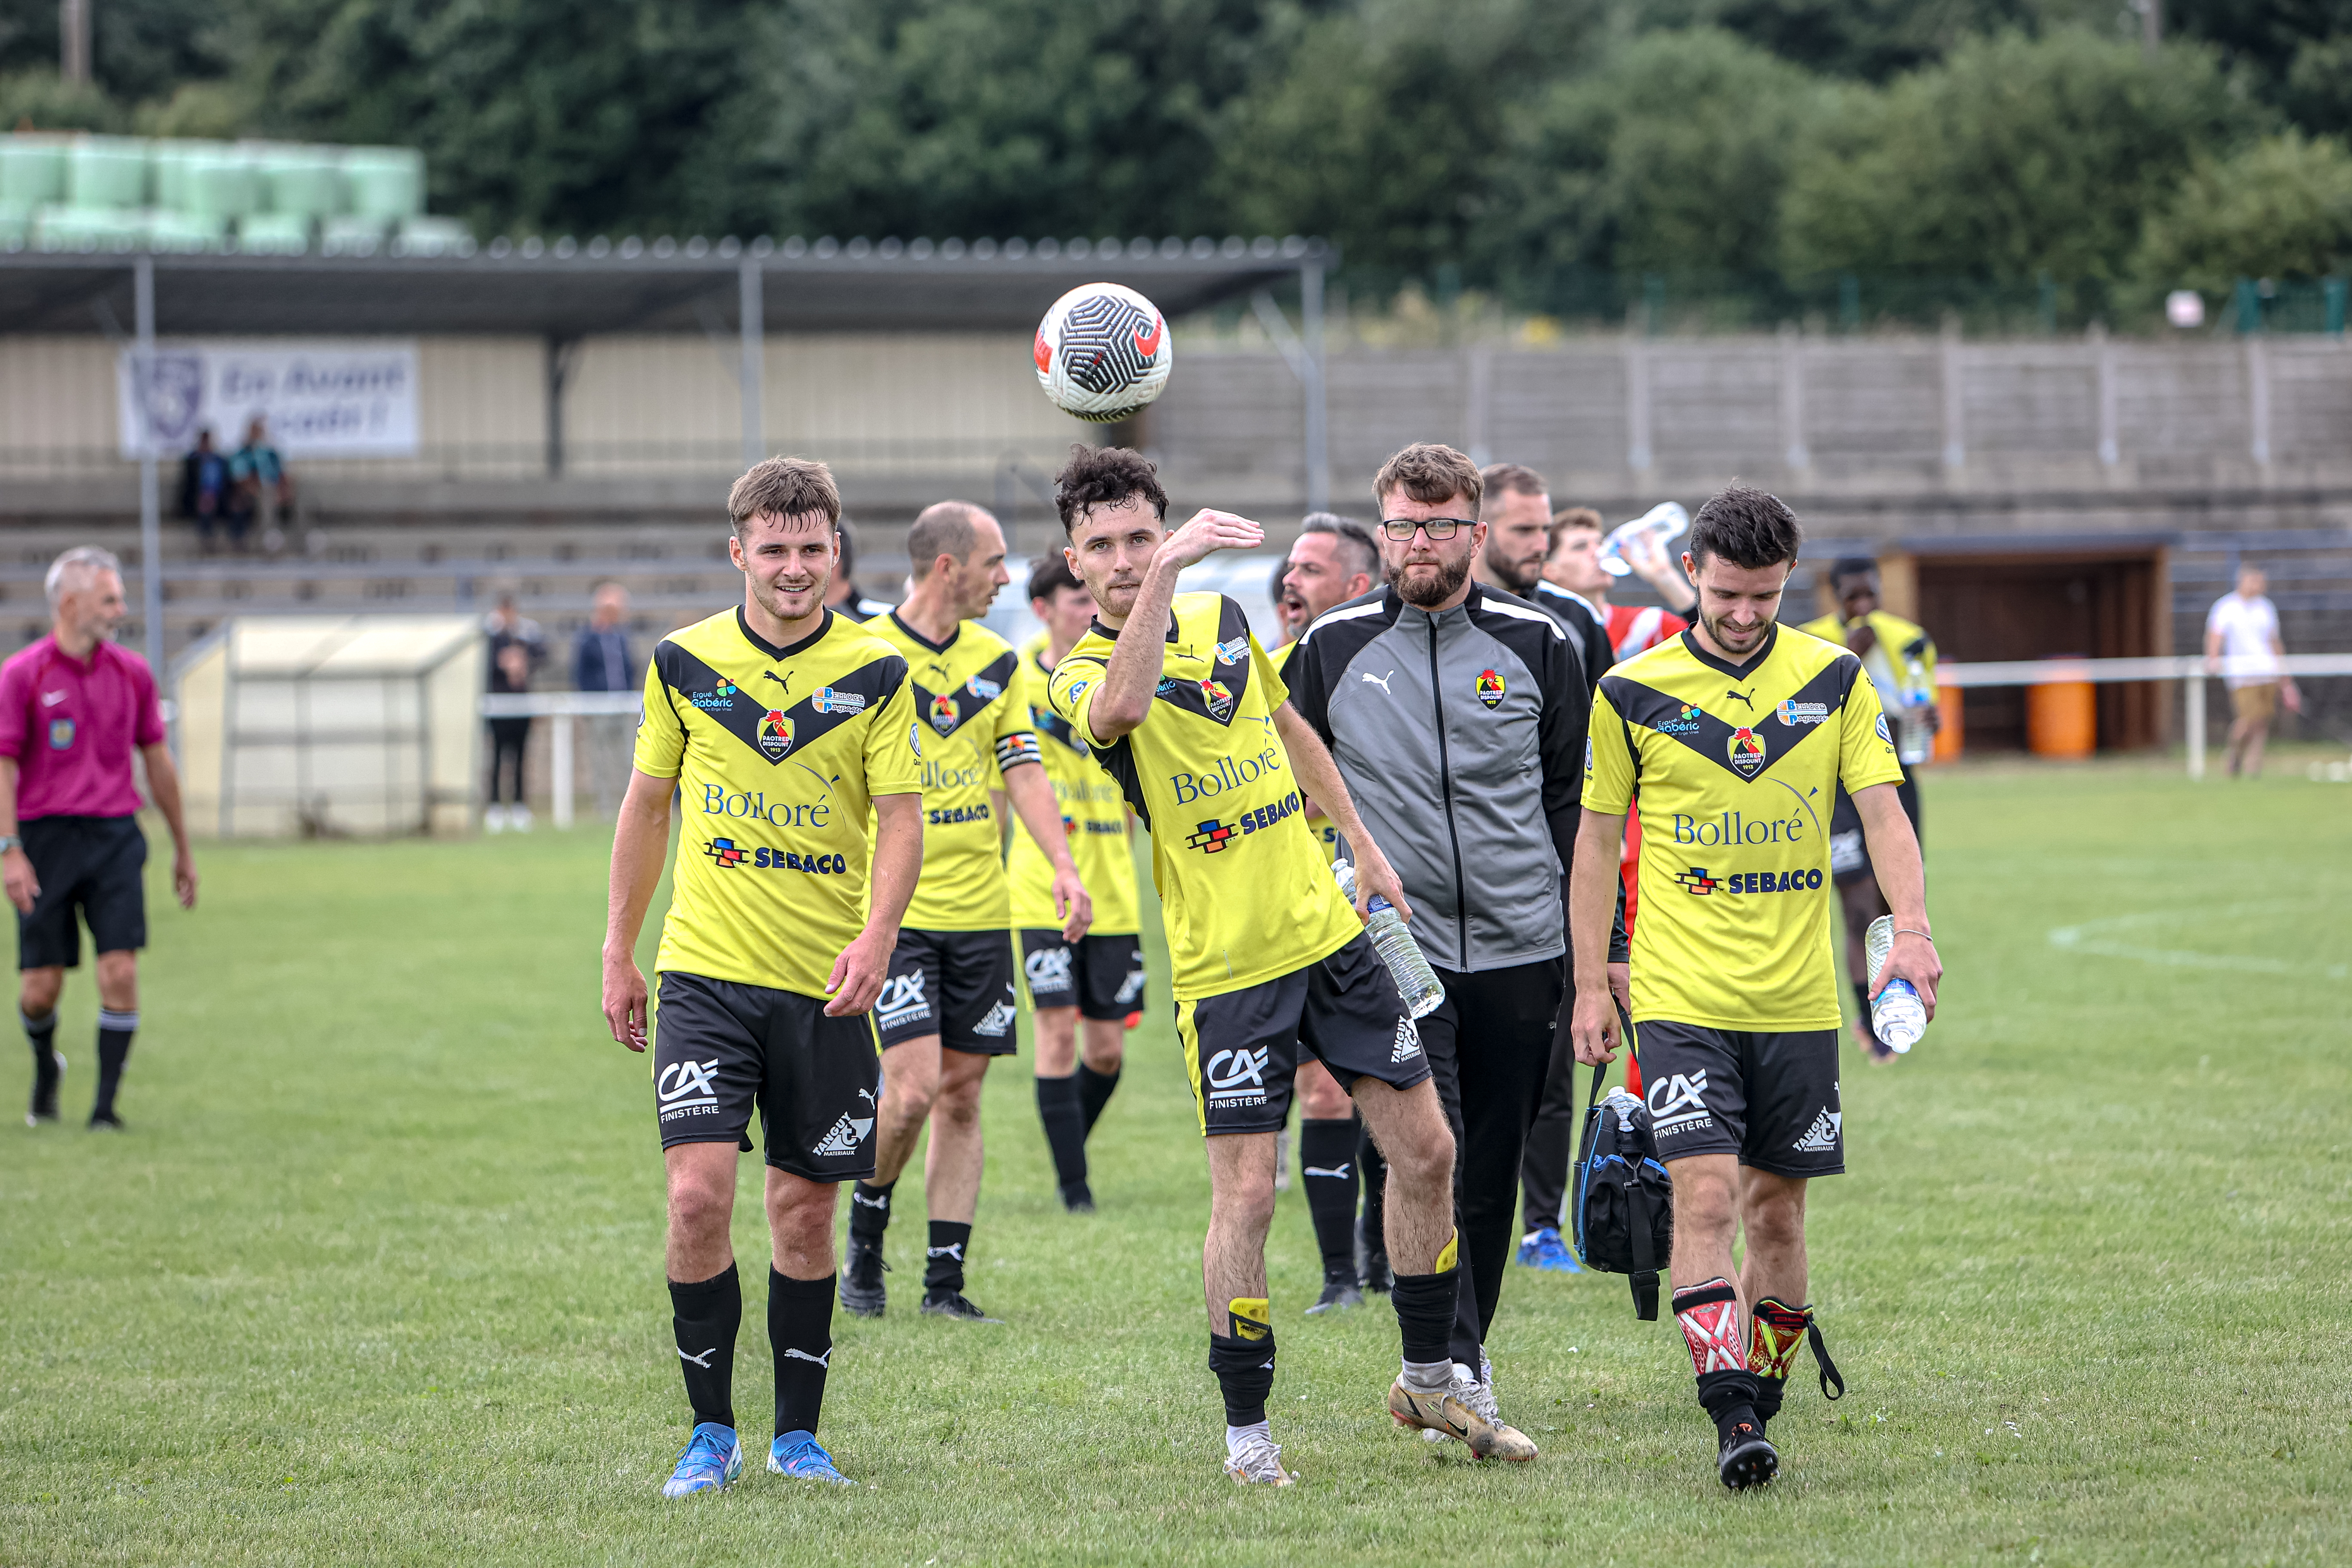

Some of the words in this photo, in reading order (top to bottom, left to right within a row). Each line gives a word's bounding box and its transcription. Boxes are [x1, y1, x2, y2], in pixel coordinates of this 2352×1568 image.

[691, 698, 733, 707] Gabéric
[825, 688, 864, 701] BELLOCQ
[1210, 696, 1231, 708] PAOTRED
[1787, 701, 1826, 710] BELLOCQ
[1211, 702, 1231, 713] DISPOUNT
[1656, 721, 1700, 732] Gabéric
[1789, 714, 1828, 724] Paysages
[1170, 738, 1280, 806] Bolloré
[703, 784, 830, 827] Bolloré
[930, 803, 989, 825] SEBACO
[1240, 791, 1300, 835] SEBACO
[1672, 808, 1803, 846] Bolloré
[754, 847, 846, 874] SEBACO
[1728, 869, 1823, 894] SEBACO
[1391, 1015, 1407, 1063] TANGUY
[1401, 1050, 1421, 1062] MATERIAUX
[1209, 1096, 1267, 1110] FINISTÈRE
[660, 1106, 720, 1124] FINISTÈRE
[812, 1111, 851, 1156] TANGUY
[1654, 1118, 1713, 1141] FINISTÈRE
[1792, 1105, 1829, 1152] TANGUY
